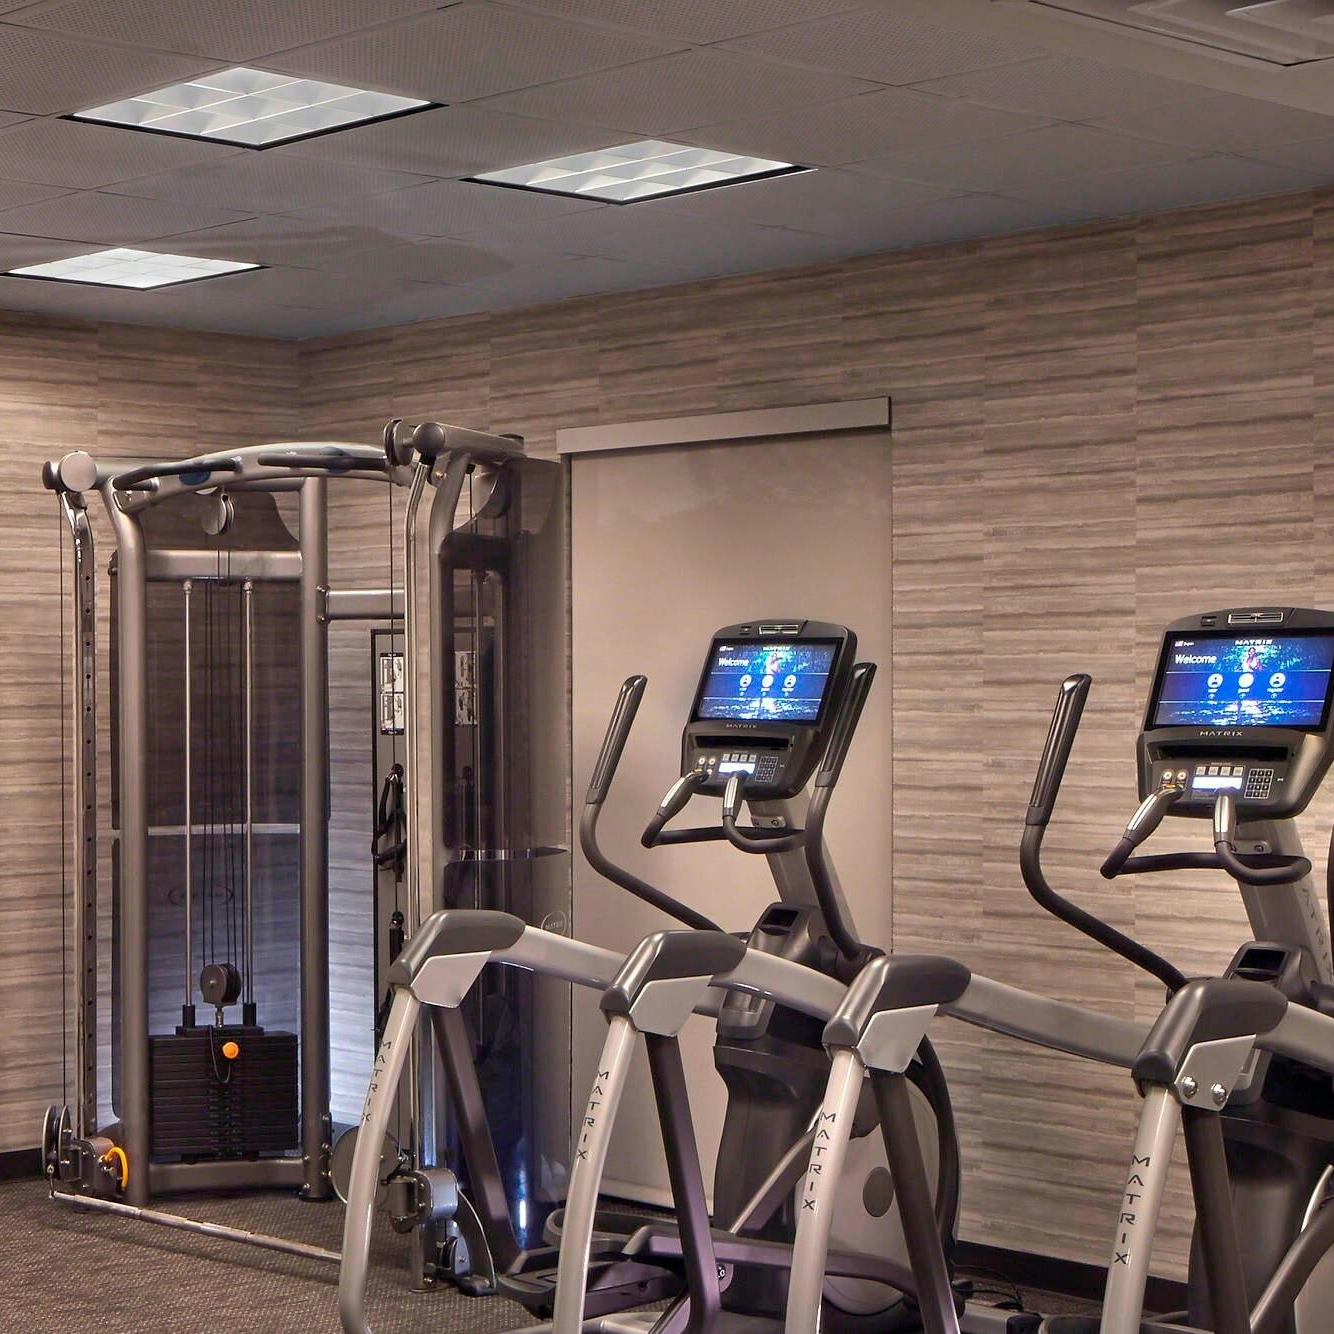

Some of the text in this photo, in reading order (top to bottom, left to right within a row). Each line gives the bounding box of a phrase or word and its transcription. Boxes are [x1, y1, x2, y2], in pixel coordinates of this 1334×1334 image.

[719, 657, 749, 666] Welcome
[1175, 654, 1217, 664] Welcome
[360, 1039, 393, 1122] MATRIX
[576, 1070, 610, 1161] MATRIX
[802, 1111, 837, 1211] MATRIX
[1113, 1154, 1151, 1266] MATRIX
